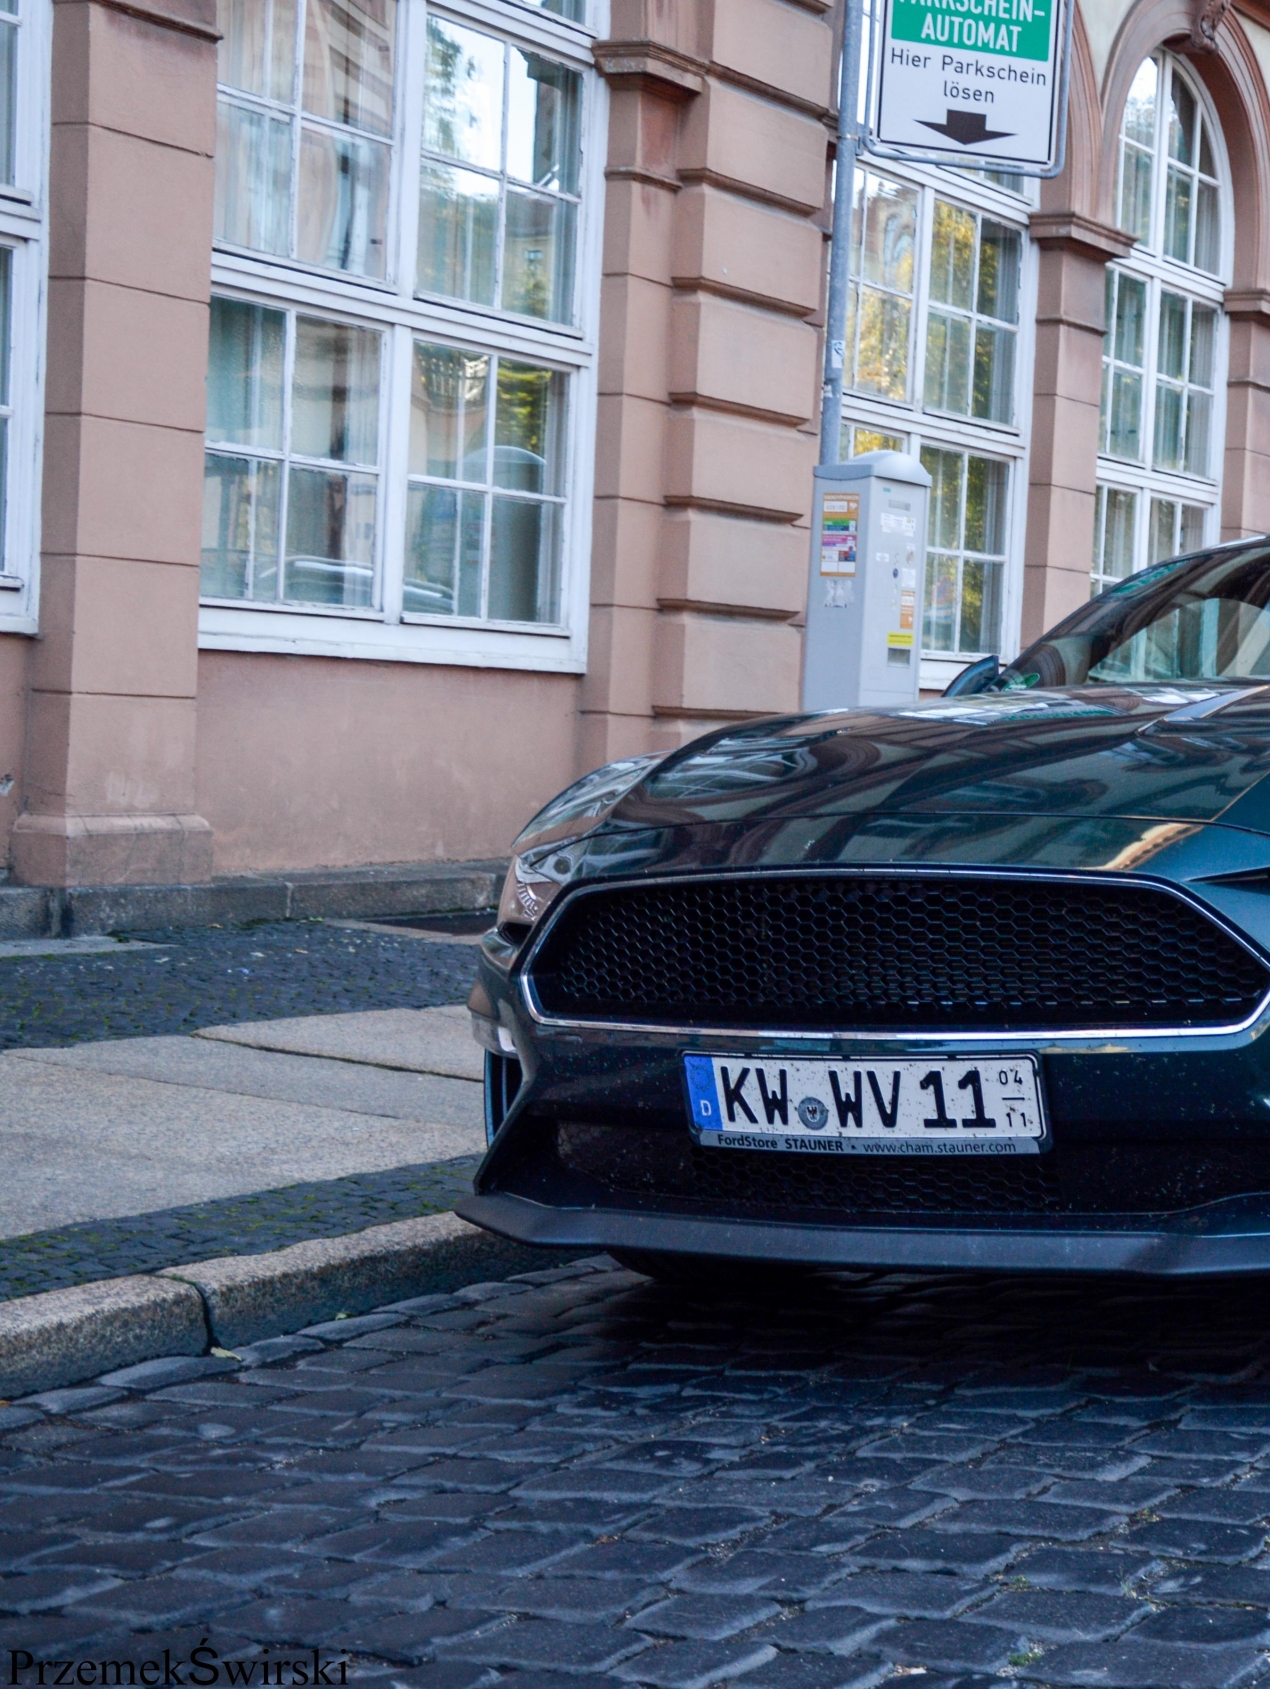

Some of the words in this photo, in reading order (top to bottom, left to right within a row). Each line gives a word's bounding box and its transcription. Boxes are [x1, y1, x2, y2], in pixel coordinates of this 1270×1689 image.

[921, 12, 1023, 53] AUTOMAT
[890, 47, 931, 69] Hier
[941, 54, 1047, 86] Parkschein
[944, 80, 995, 103] lösen
[999, 1069, 1024, 1086] 04
[720, 1065, 789, 1126] KW
[828, 1069, 902, 1129] WV
[919, 1069, 997, 1129] 11
[701, 1099, 712, 1117] D
[1004, 1110, 1028, 1128] 11
[717, 1133, 778, 1149] FordStore
[784, 1137, 844, 1152] STAUNER
